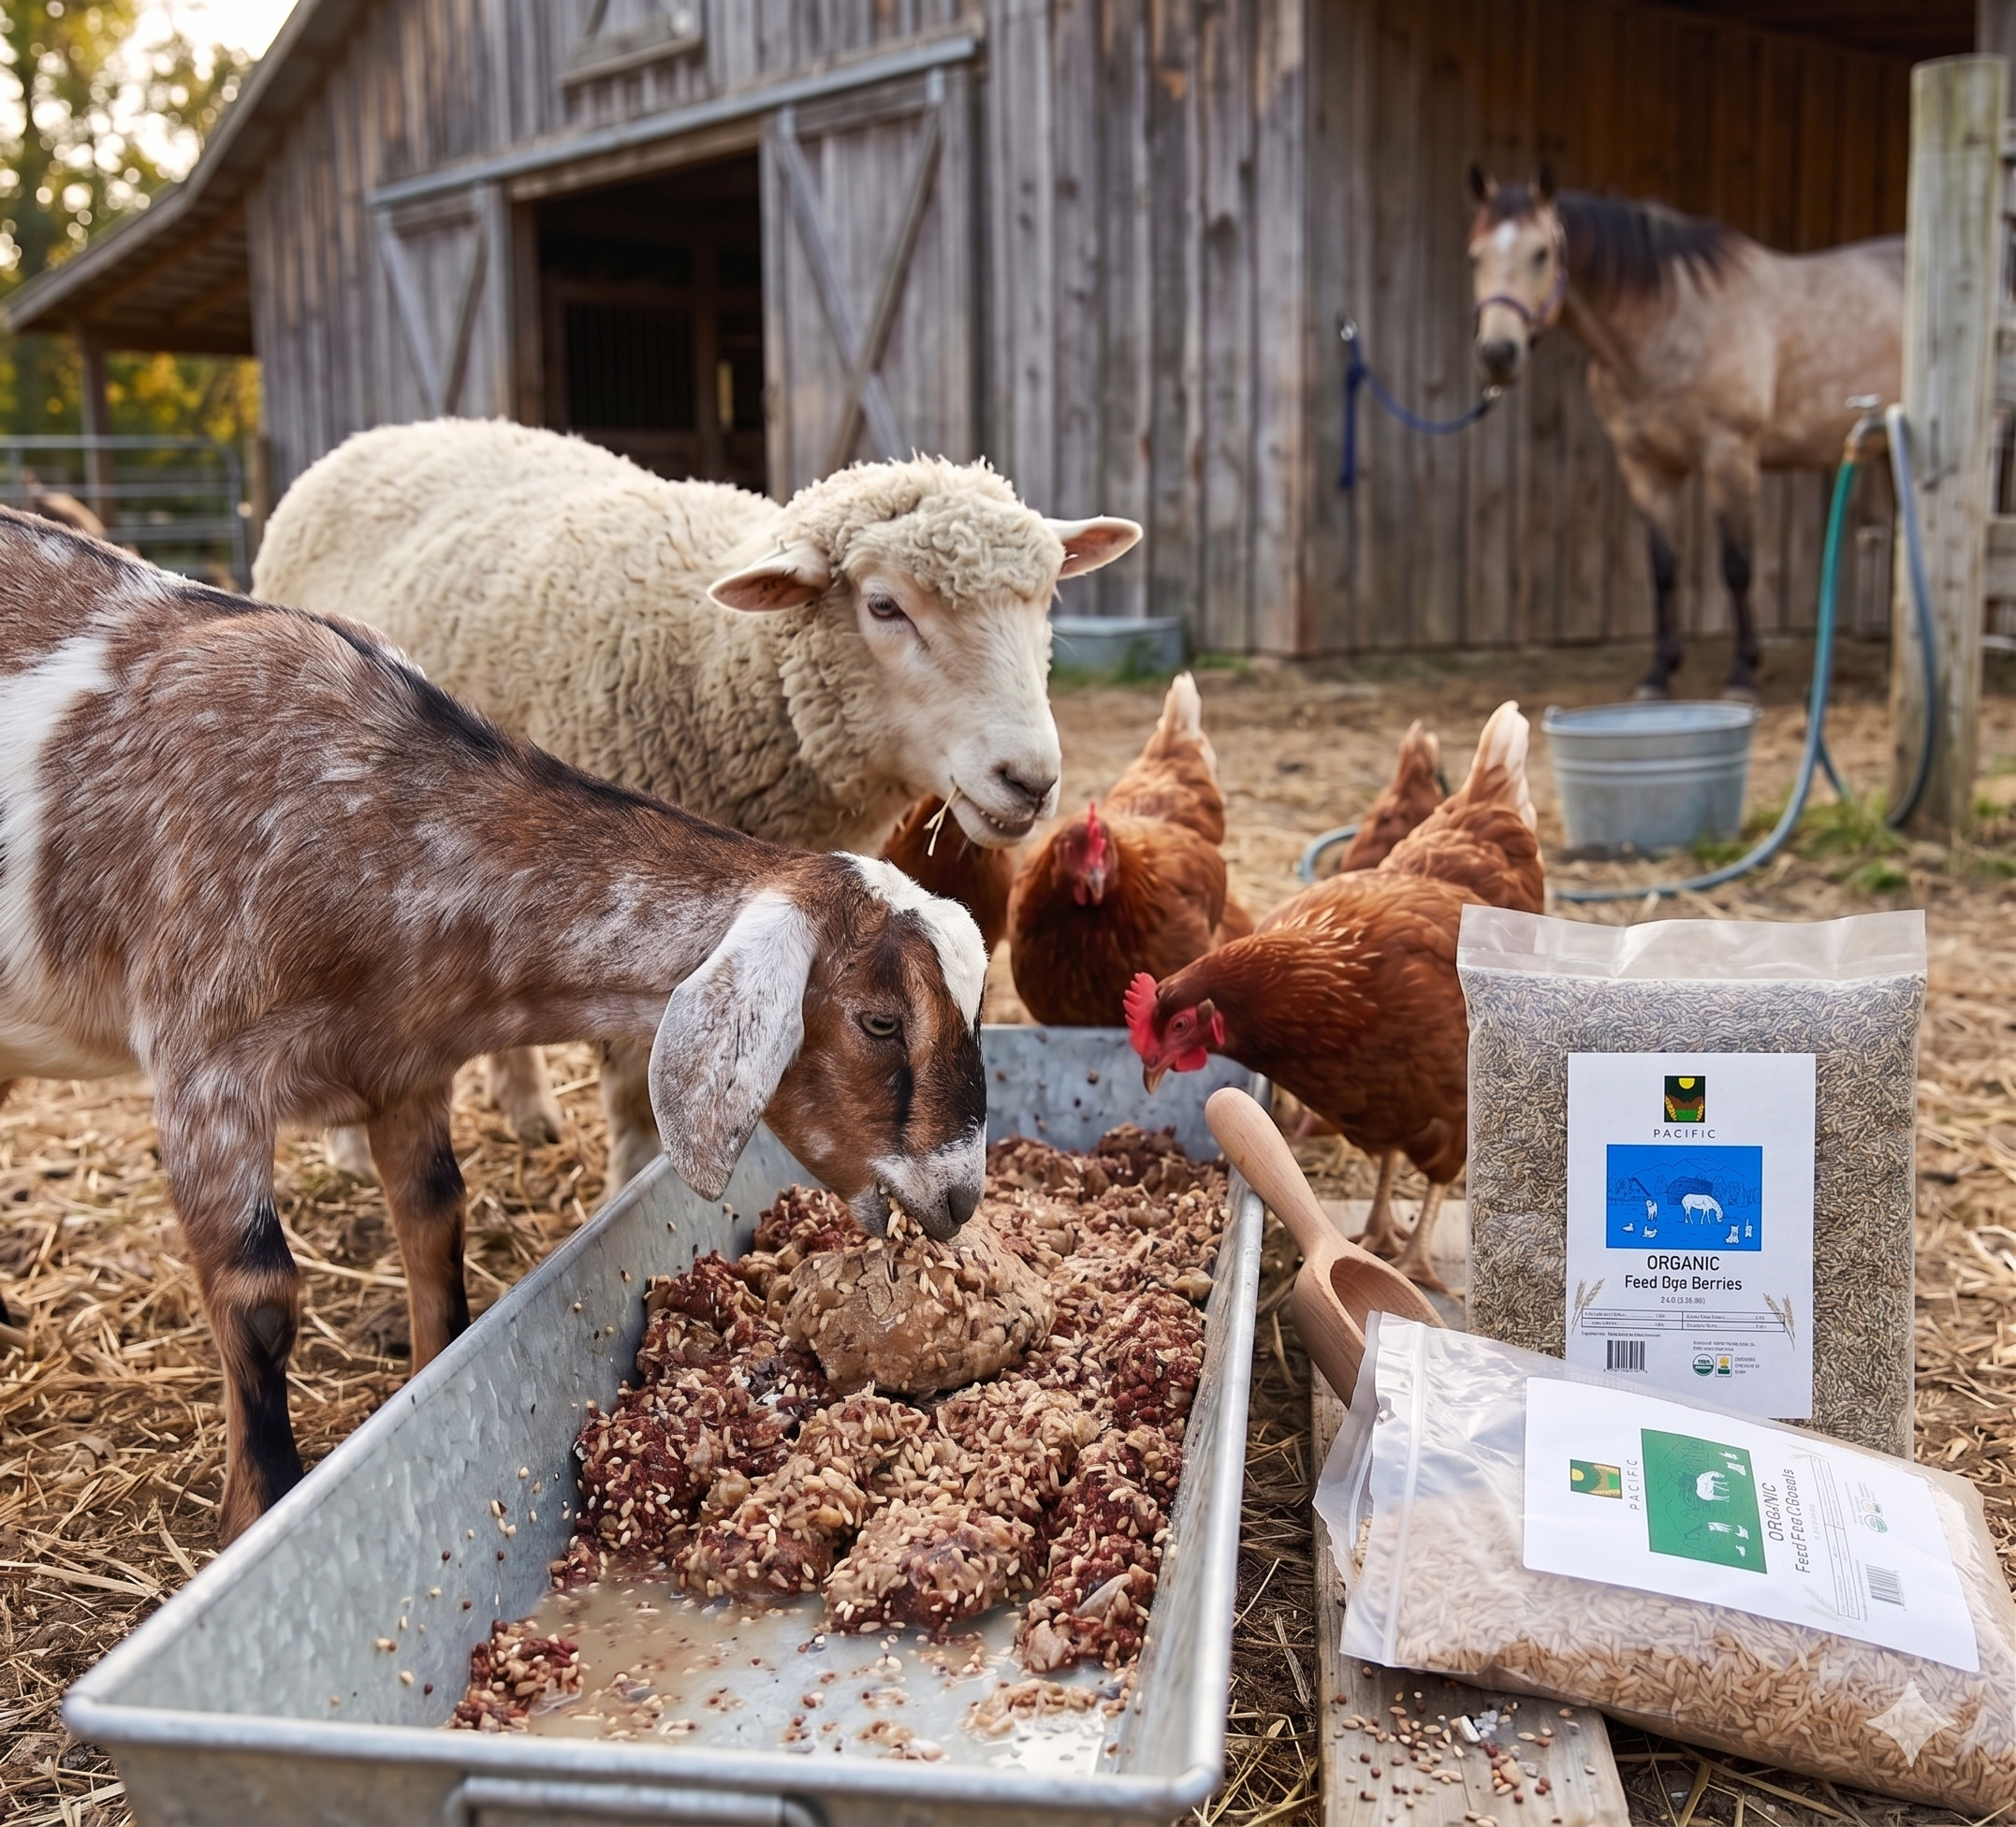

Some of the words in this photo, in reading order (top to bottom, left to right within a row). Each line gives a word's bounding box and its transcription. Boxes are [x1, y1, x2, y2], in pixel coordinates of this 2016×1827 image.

[1653, 1129, 1717, 1139] PACIFIC
[1647, 1255, 1720, 1271] ORGANIC
[1625, 1275, 1658, 1289] Feed
[1692, 1276, 1743, 1291] Berries
[1627, 1459, 1641, 1511] PACIFIC
